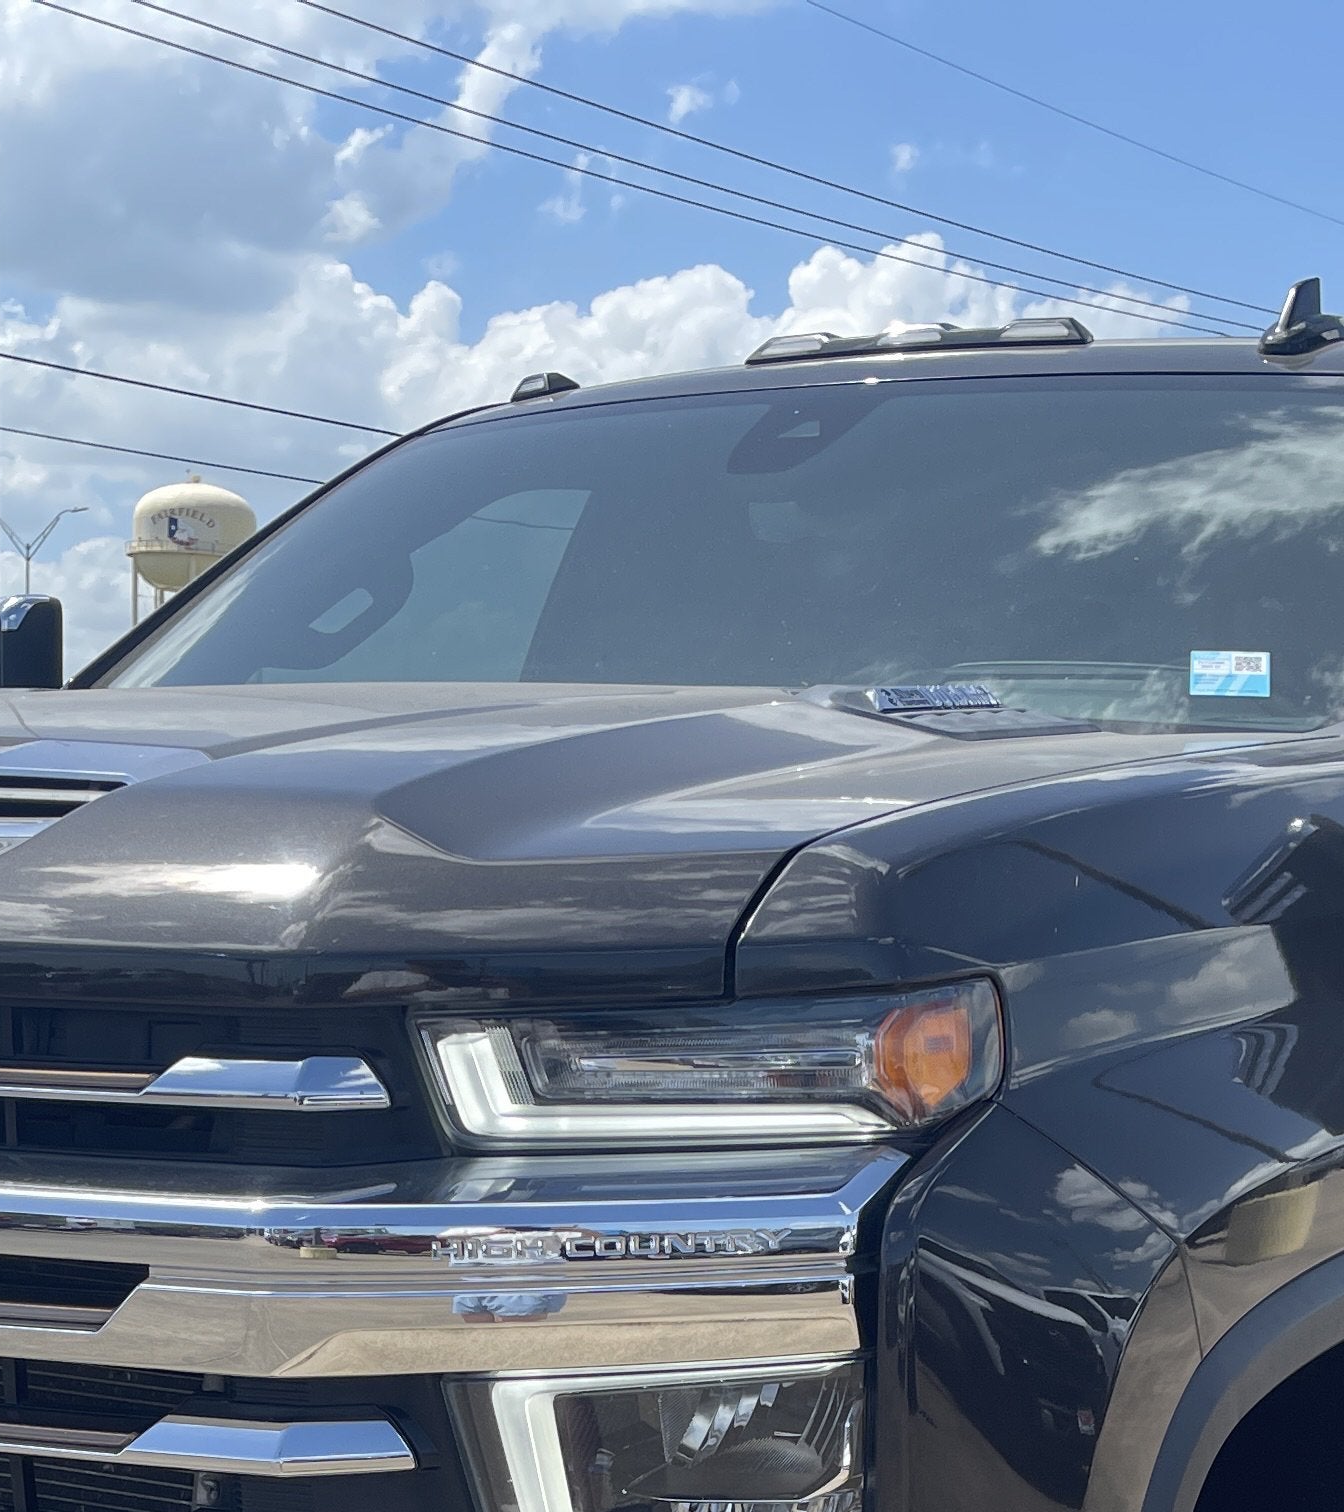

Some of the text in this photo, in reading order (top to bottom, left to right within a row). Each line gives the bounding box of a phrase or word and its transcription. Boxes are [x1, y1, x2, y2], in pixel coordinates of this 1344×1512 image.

[150, 508, 216, 528] FAIRFIELD
[431, 1228, 792, 1262] HIGH COUNTRY
